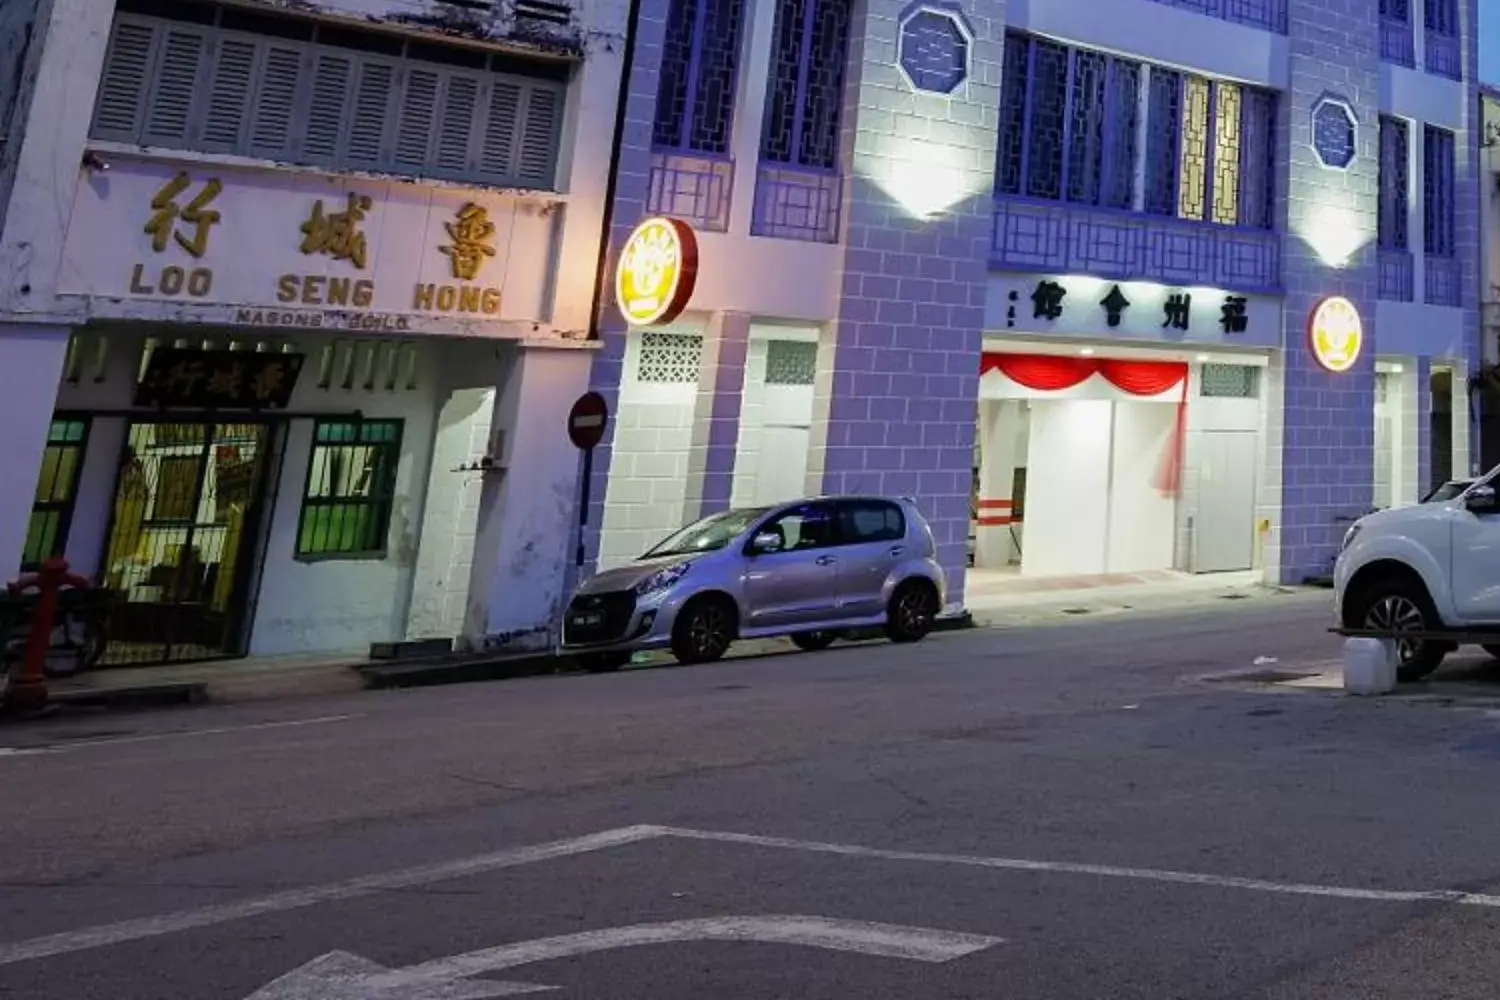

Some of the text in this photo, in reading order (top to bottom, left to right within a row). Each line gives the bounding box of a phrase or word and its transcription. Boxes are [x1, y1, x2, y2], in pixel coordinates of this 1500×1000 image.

[129, 263, 503, 315] LOO SENG HONG
